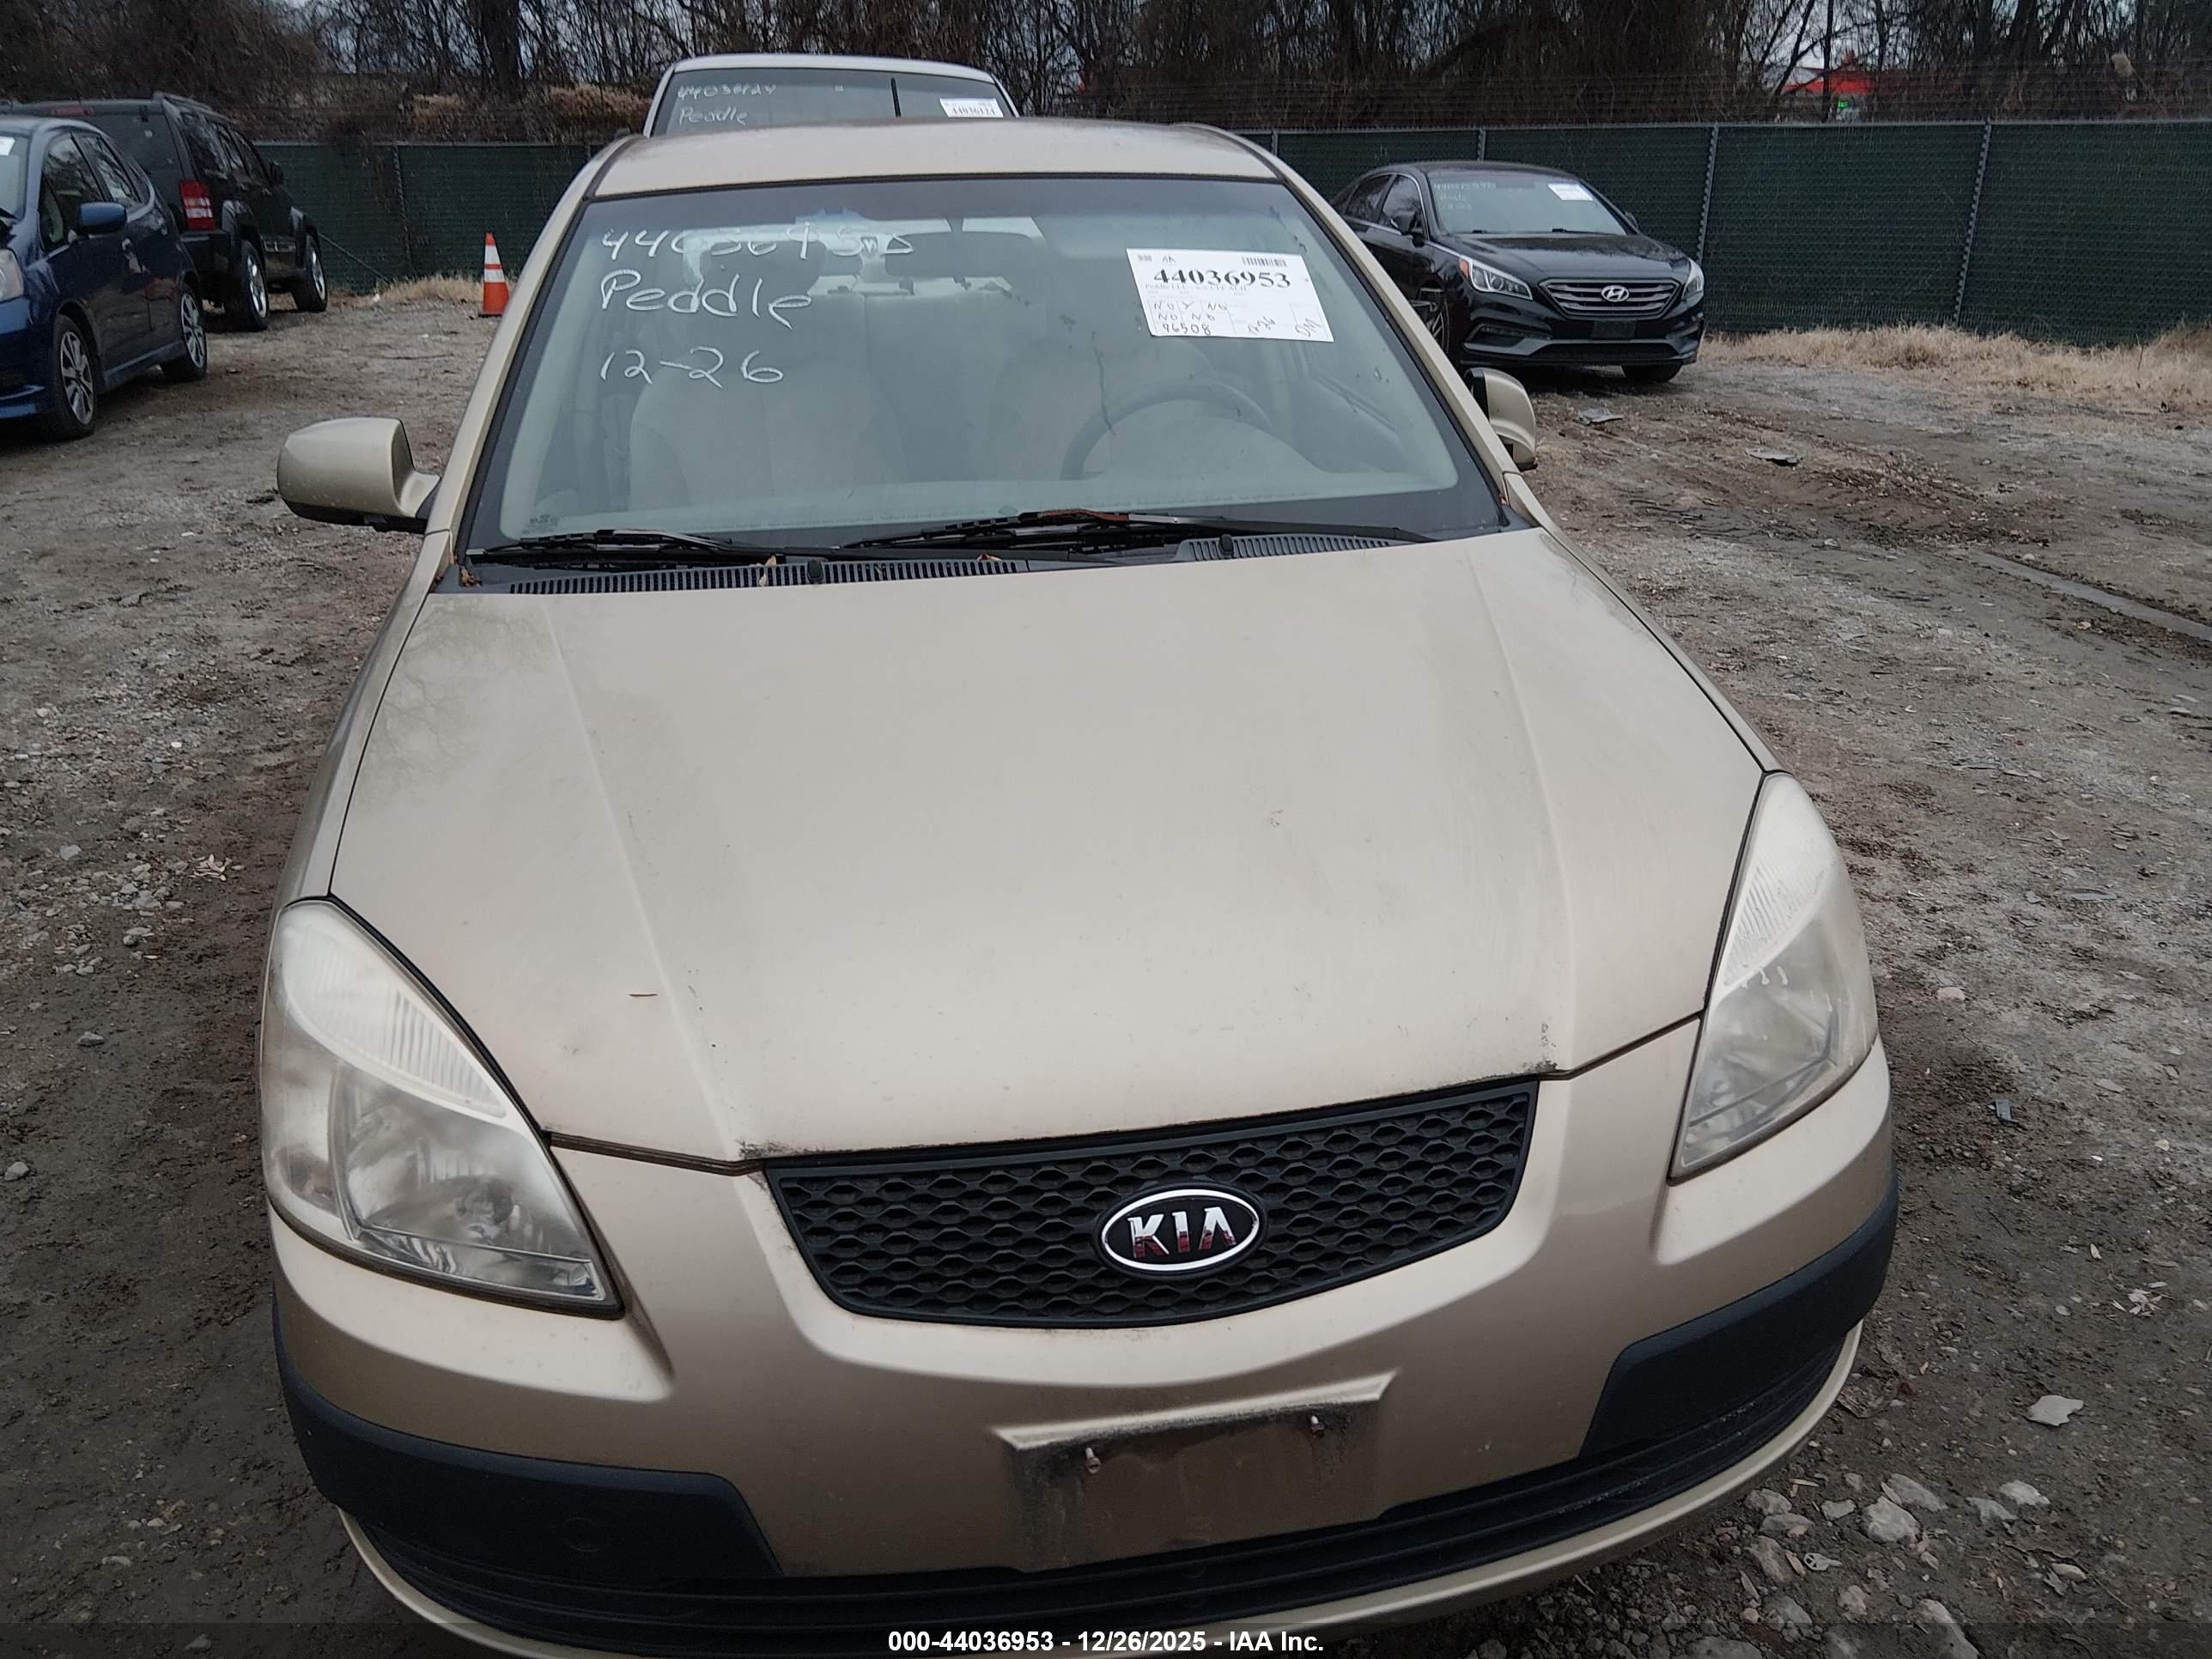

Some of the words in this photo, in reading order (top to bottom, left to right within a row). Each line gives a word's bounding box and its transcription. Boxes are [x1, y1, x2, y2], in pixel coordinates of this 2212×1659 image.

[600, 269, 812, 331] Peddle
[1153, 268, 1291, 289] 44036953
[1127, 1206, 1237, 1259] KIA
